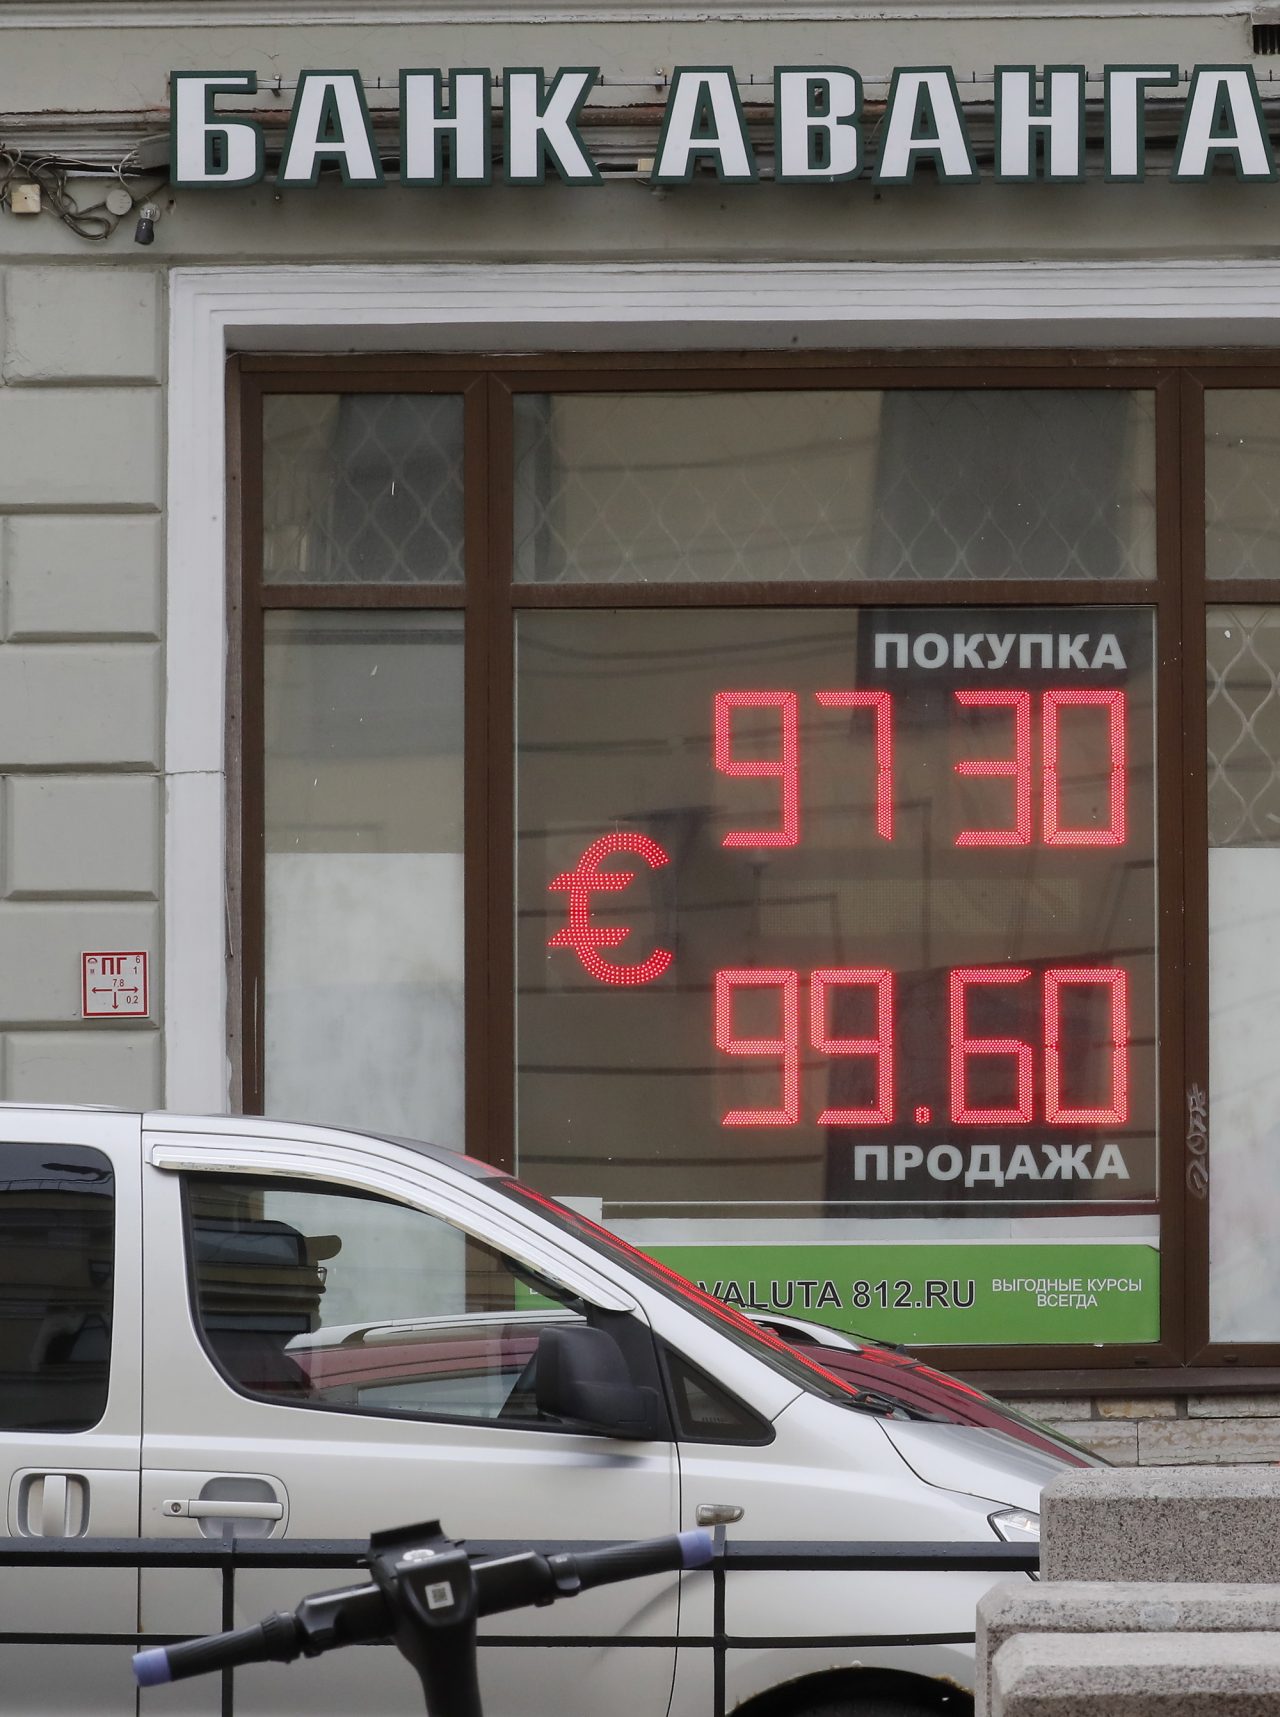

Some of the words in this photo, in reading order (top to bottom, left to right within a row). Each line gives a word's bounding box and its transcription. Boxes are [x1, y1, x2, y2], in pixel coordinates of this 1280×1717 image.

[170, 66, 604, 188] БАНК
[874, 633, 1128, 669] ПОКУПКА
[101, 957, 128, 976] ПГ
[133, 966, 138, 975] 1
[713, 969, 1128, 1125] 99.60
[854, 1144, 1131, 1188] ПРОДАЖА
[698, 1280, 843, 1309] VALUTA
[852, 1279, 976, 1308] 812.RU
[992, 1278, 1082, 1294] ВЫГОДНЫЕ
[1087, 1278, 1142, 1292] КУРСЫ
[1037, 1294, 1098, 1309] ВСЕГДА
